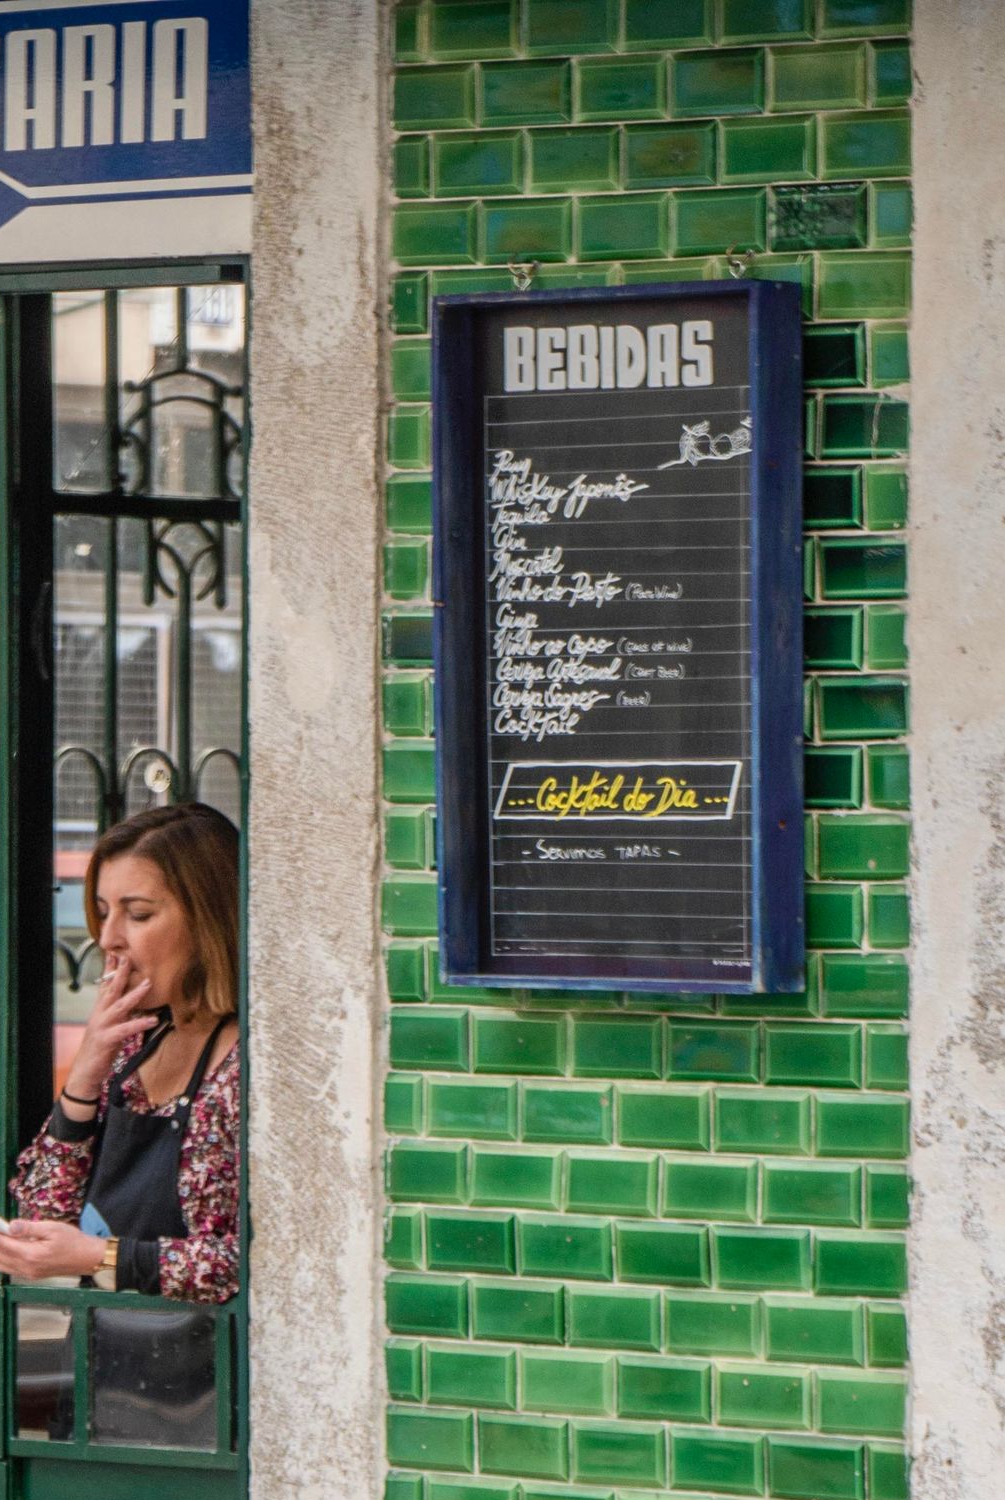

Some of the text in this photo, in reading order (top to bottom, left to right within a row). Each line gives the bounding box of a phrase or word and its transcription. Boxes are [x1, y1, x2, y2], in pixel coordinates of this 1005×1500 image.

[504, 320, 714, 392] BEBIDAS
[491, 502, 551, 533] Tequila
[493, 525, 528, 556] Gin
[496, 575, 545, 601] Vinho
[567, 571, 623, 608] Porto
[567, 634, 615, 664] Copo
[622, 776, 656, 812] do
[648, 777, 699, 818] Dia
